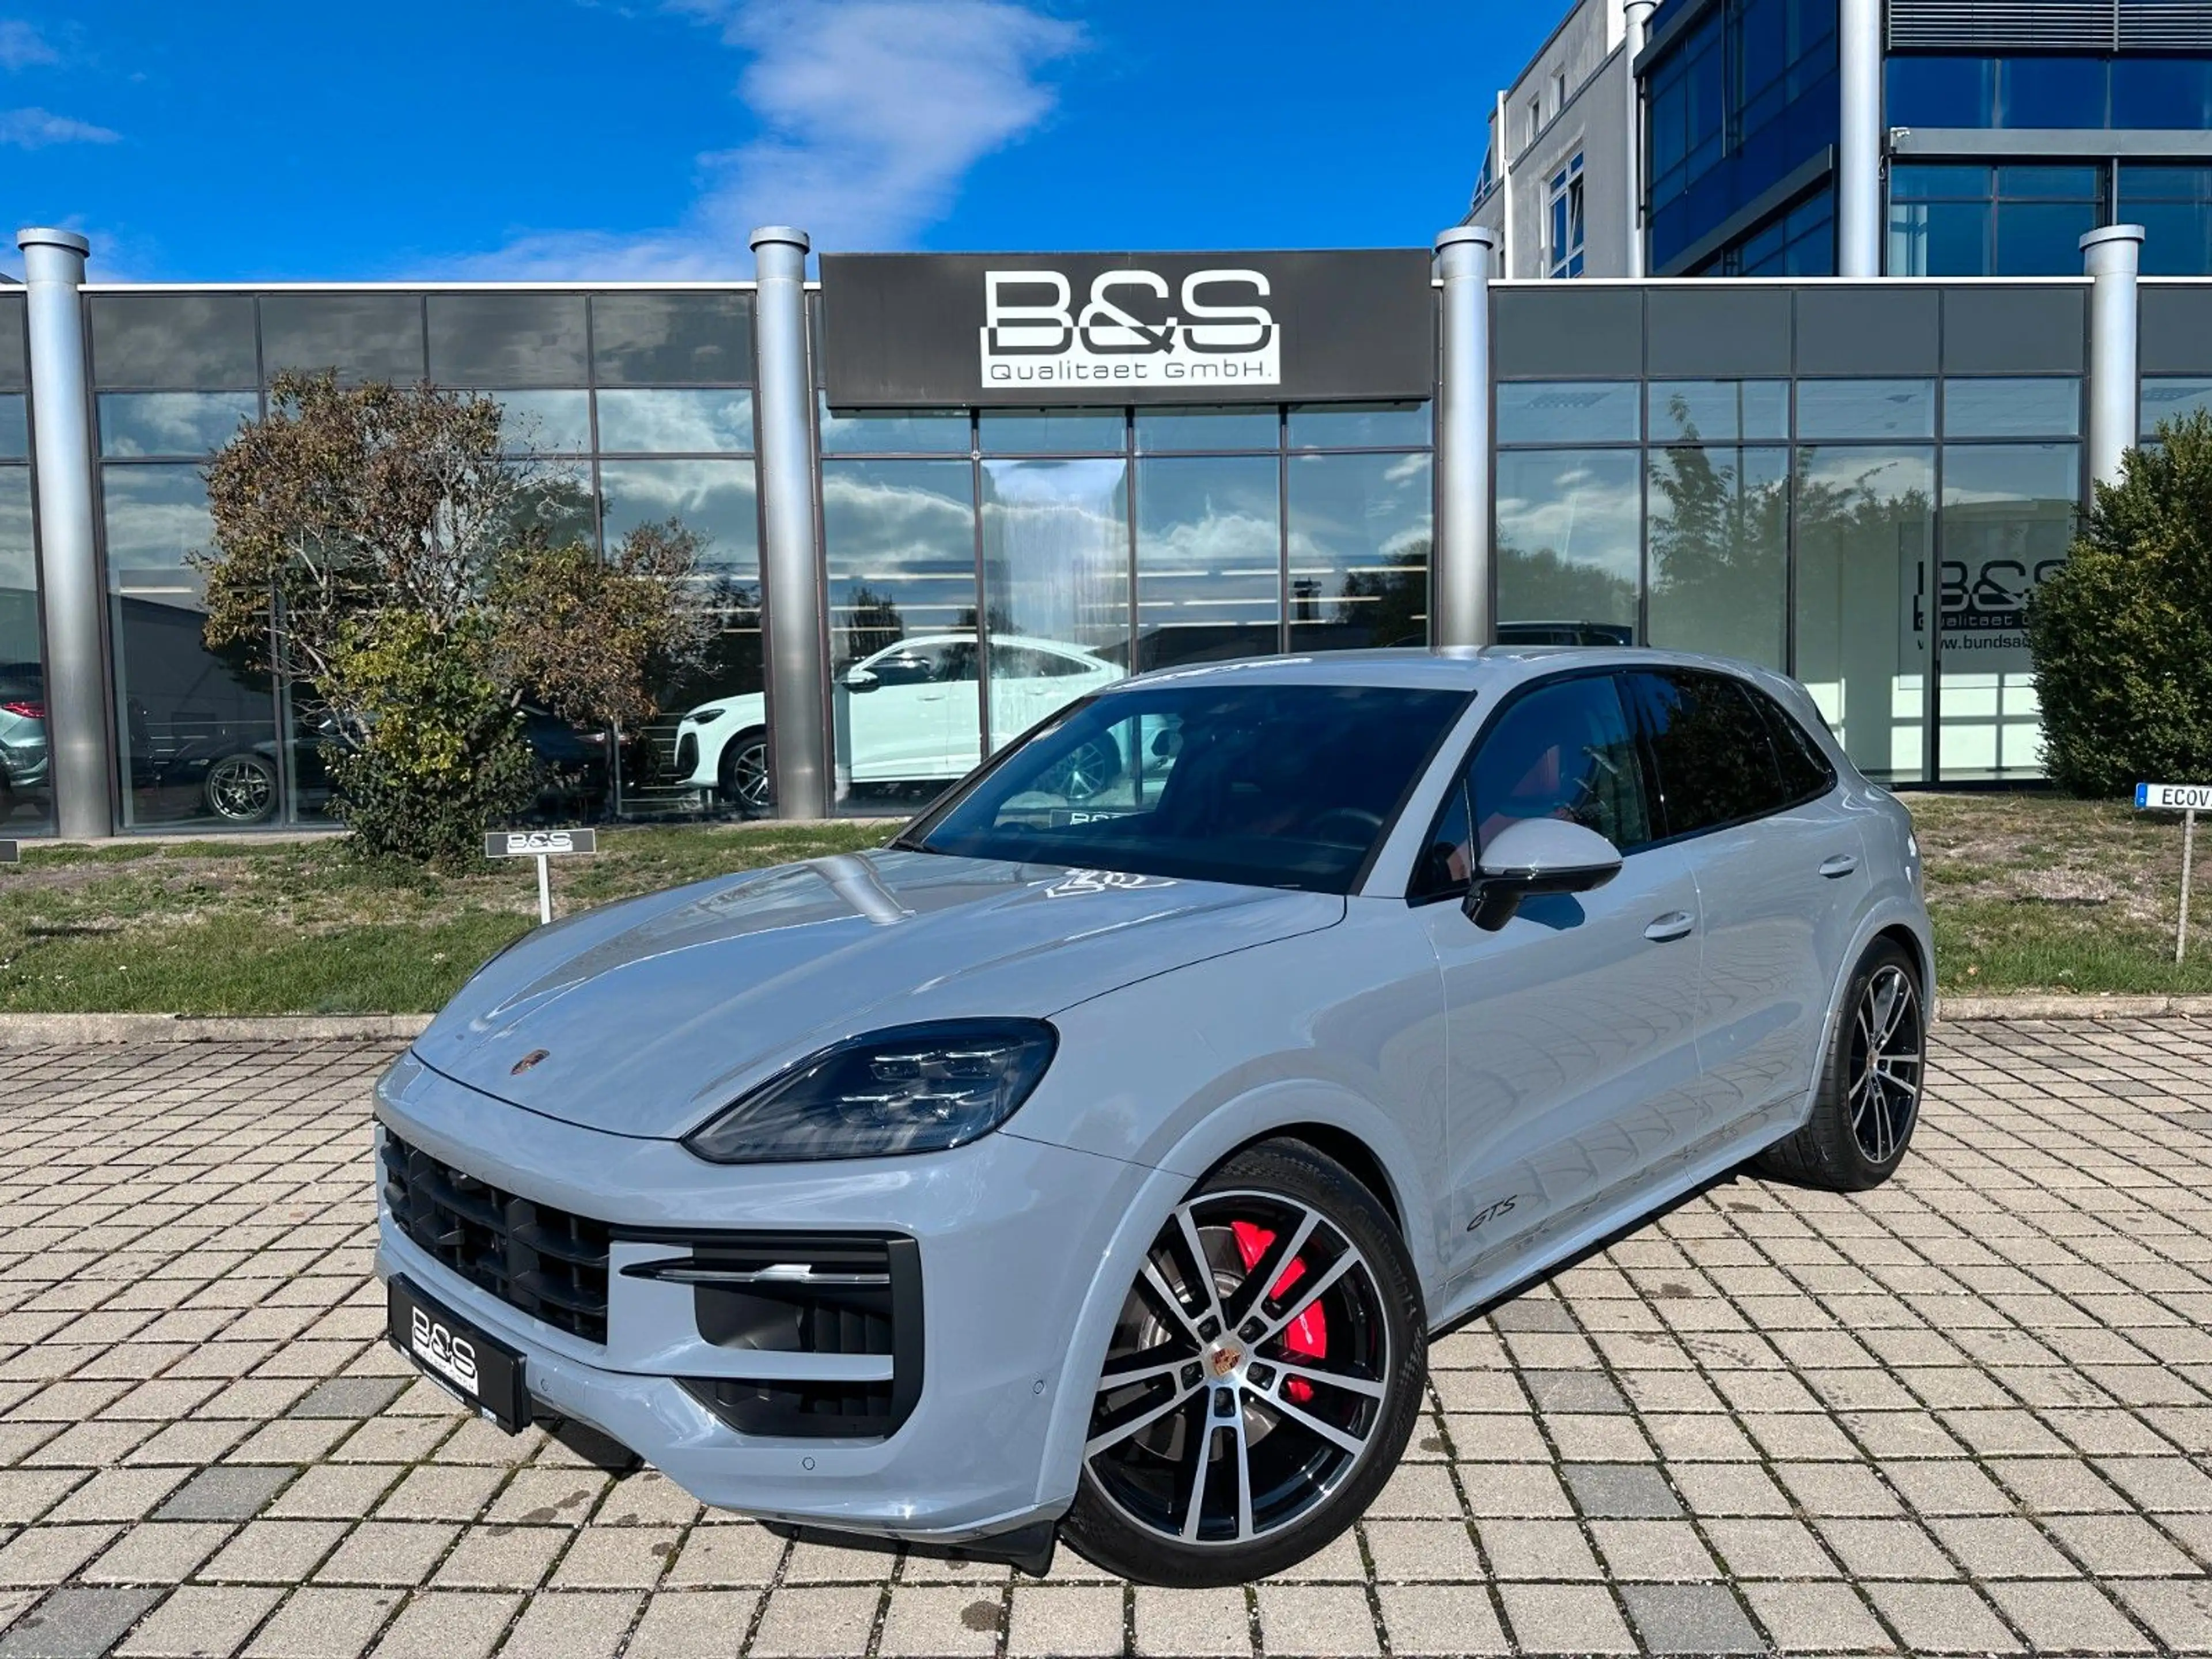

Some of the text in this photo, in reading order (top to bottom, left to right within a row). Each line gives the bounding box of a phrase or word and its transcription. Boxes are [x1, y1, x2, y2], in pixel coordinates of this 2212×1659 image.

[986, 270, 1272, 355] B&S
[991, 358, 1271, 380] Qualitaet GmbH.
[1918, 613, 2013, 627] alitaet
[2162, 789, 2212, 806] ECOV
[508, 833, 571, 849] B&S
[1467, 1194, 1518, 1232] GTS
[412, 1306, 477, 1379] B&S
